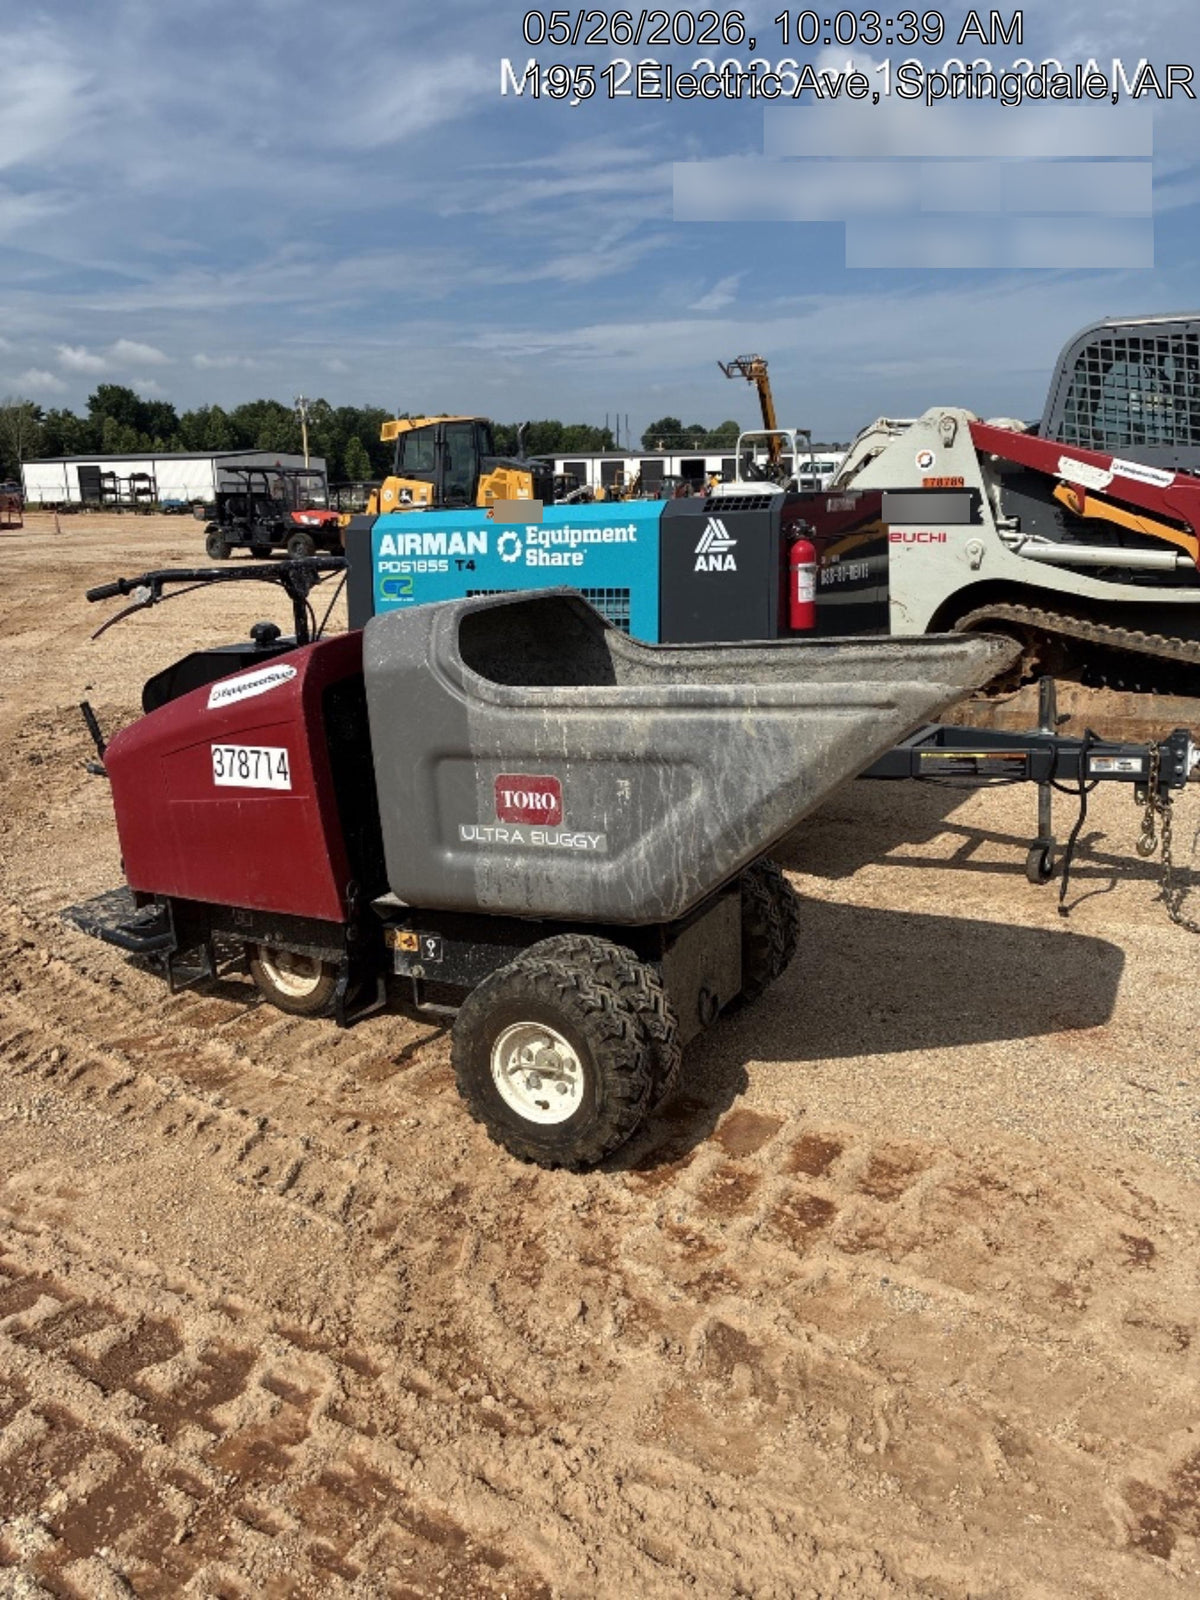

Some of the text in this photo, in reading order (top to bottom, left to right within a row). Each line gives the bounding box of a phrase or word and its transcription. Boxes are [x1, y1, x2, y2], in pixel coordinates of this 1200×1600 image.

[923, 476, 965, 487] 78789
[379, 531, 488, 557] AIRMAN
[525, 524, 637, 549] Equipment
[455, 559, 476, 571] T4
[525, 548, 584, 567] Share
[694, 553, 738, 572] ANA
[212, 747, 288, 781] 378714
[501, 790, 557, 810] TORO
[461, 825, 601, 849] ULTRA BUGGY
